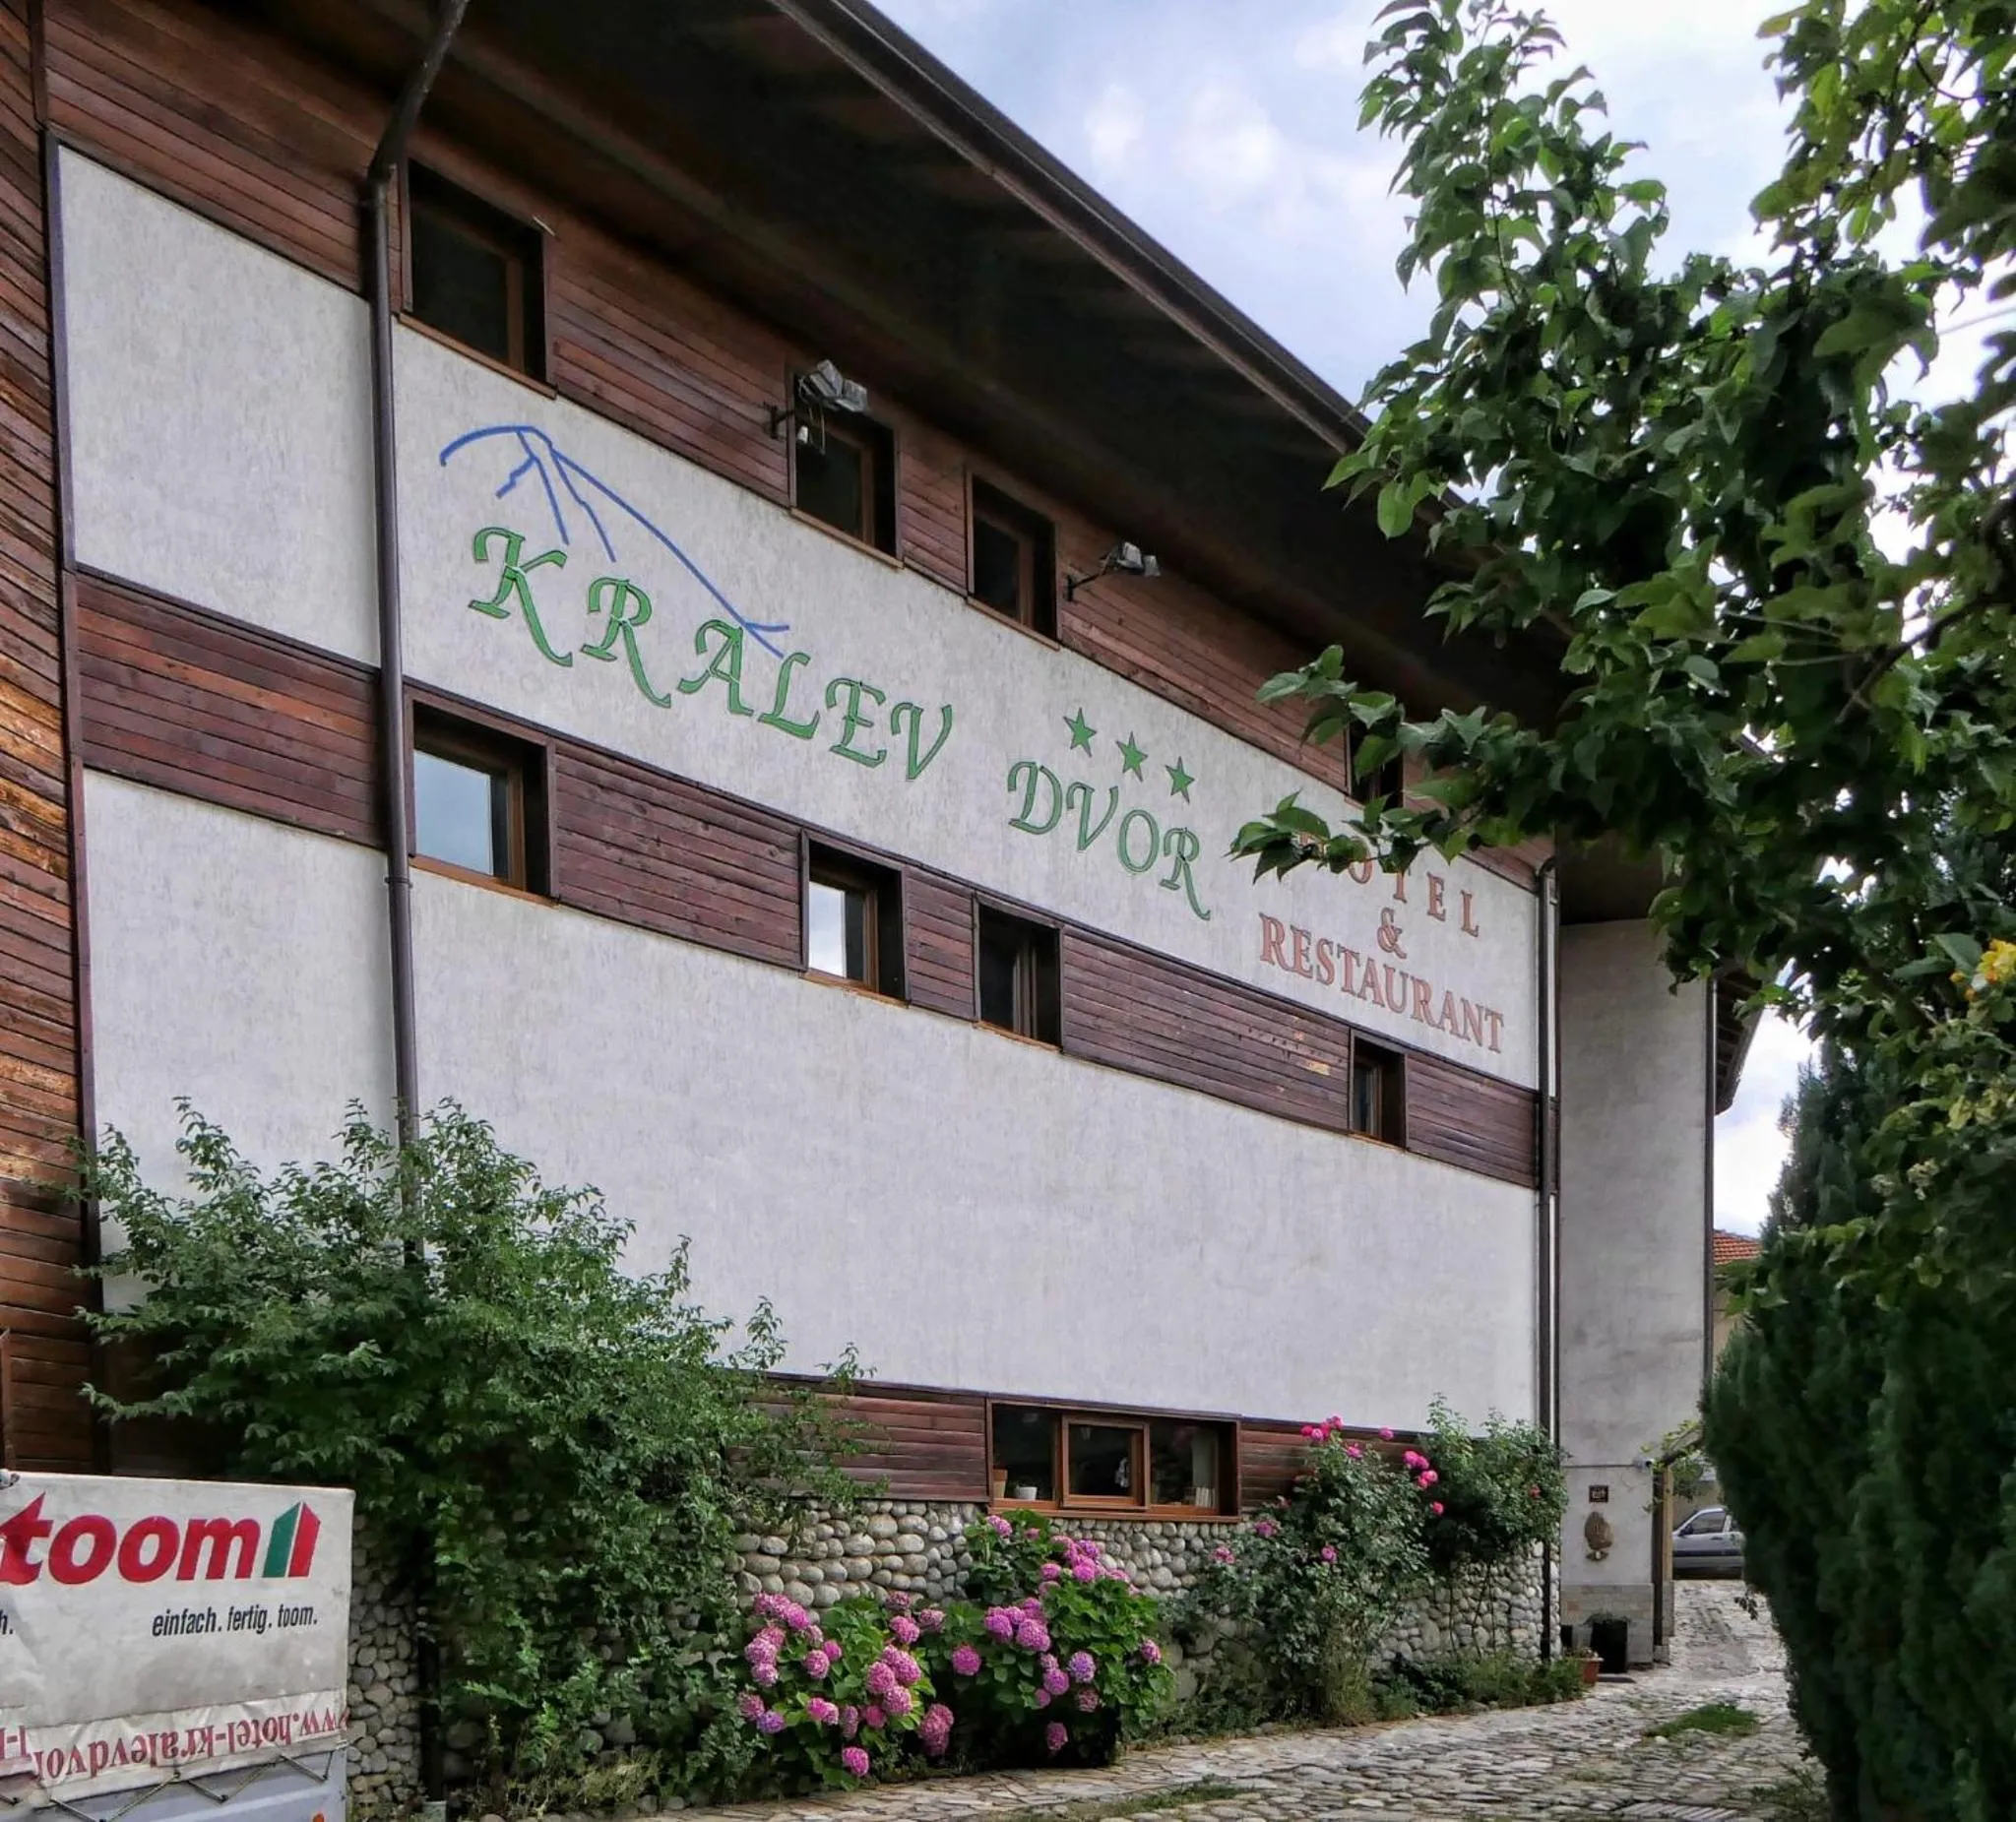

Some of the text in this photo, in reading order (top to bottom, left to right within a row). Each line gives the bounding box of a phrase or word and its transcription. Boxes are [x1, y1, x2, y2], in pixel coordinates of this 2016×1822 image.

[468, 526, 1212, 920] KRALEV DVOR
[1295, 829, 1480, 938] OTEL
[1376, 907, 1408, 960] &
[1258, 911, 1505, 1054] RESTAURANT
[0, 1490, 262, 1586] toom
[152, 1603, 318, 1637] einfach. fertig. toom.
